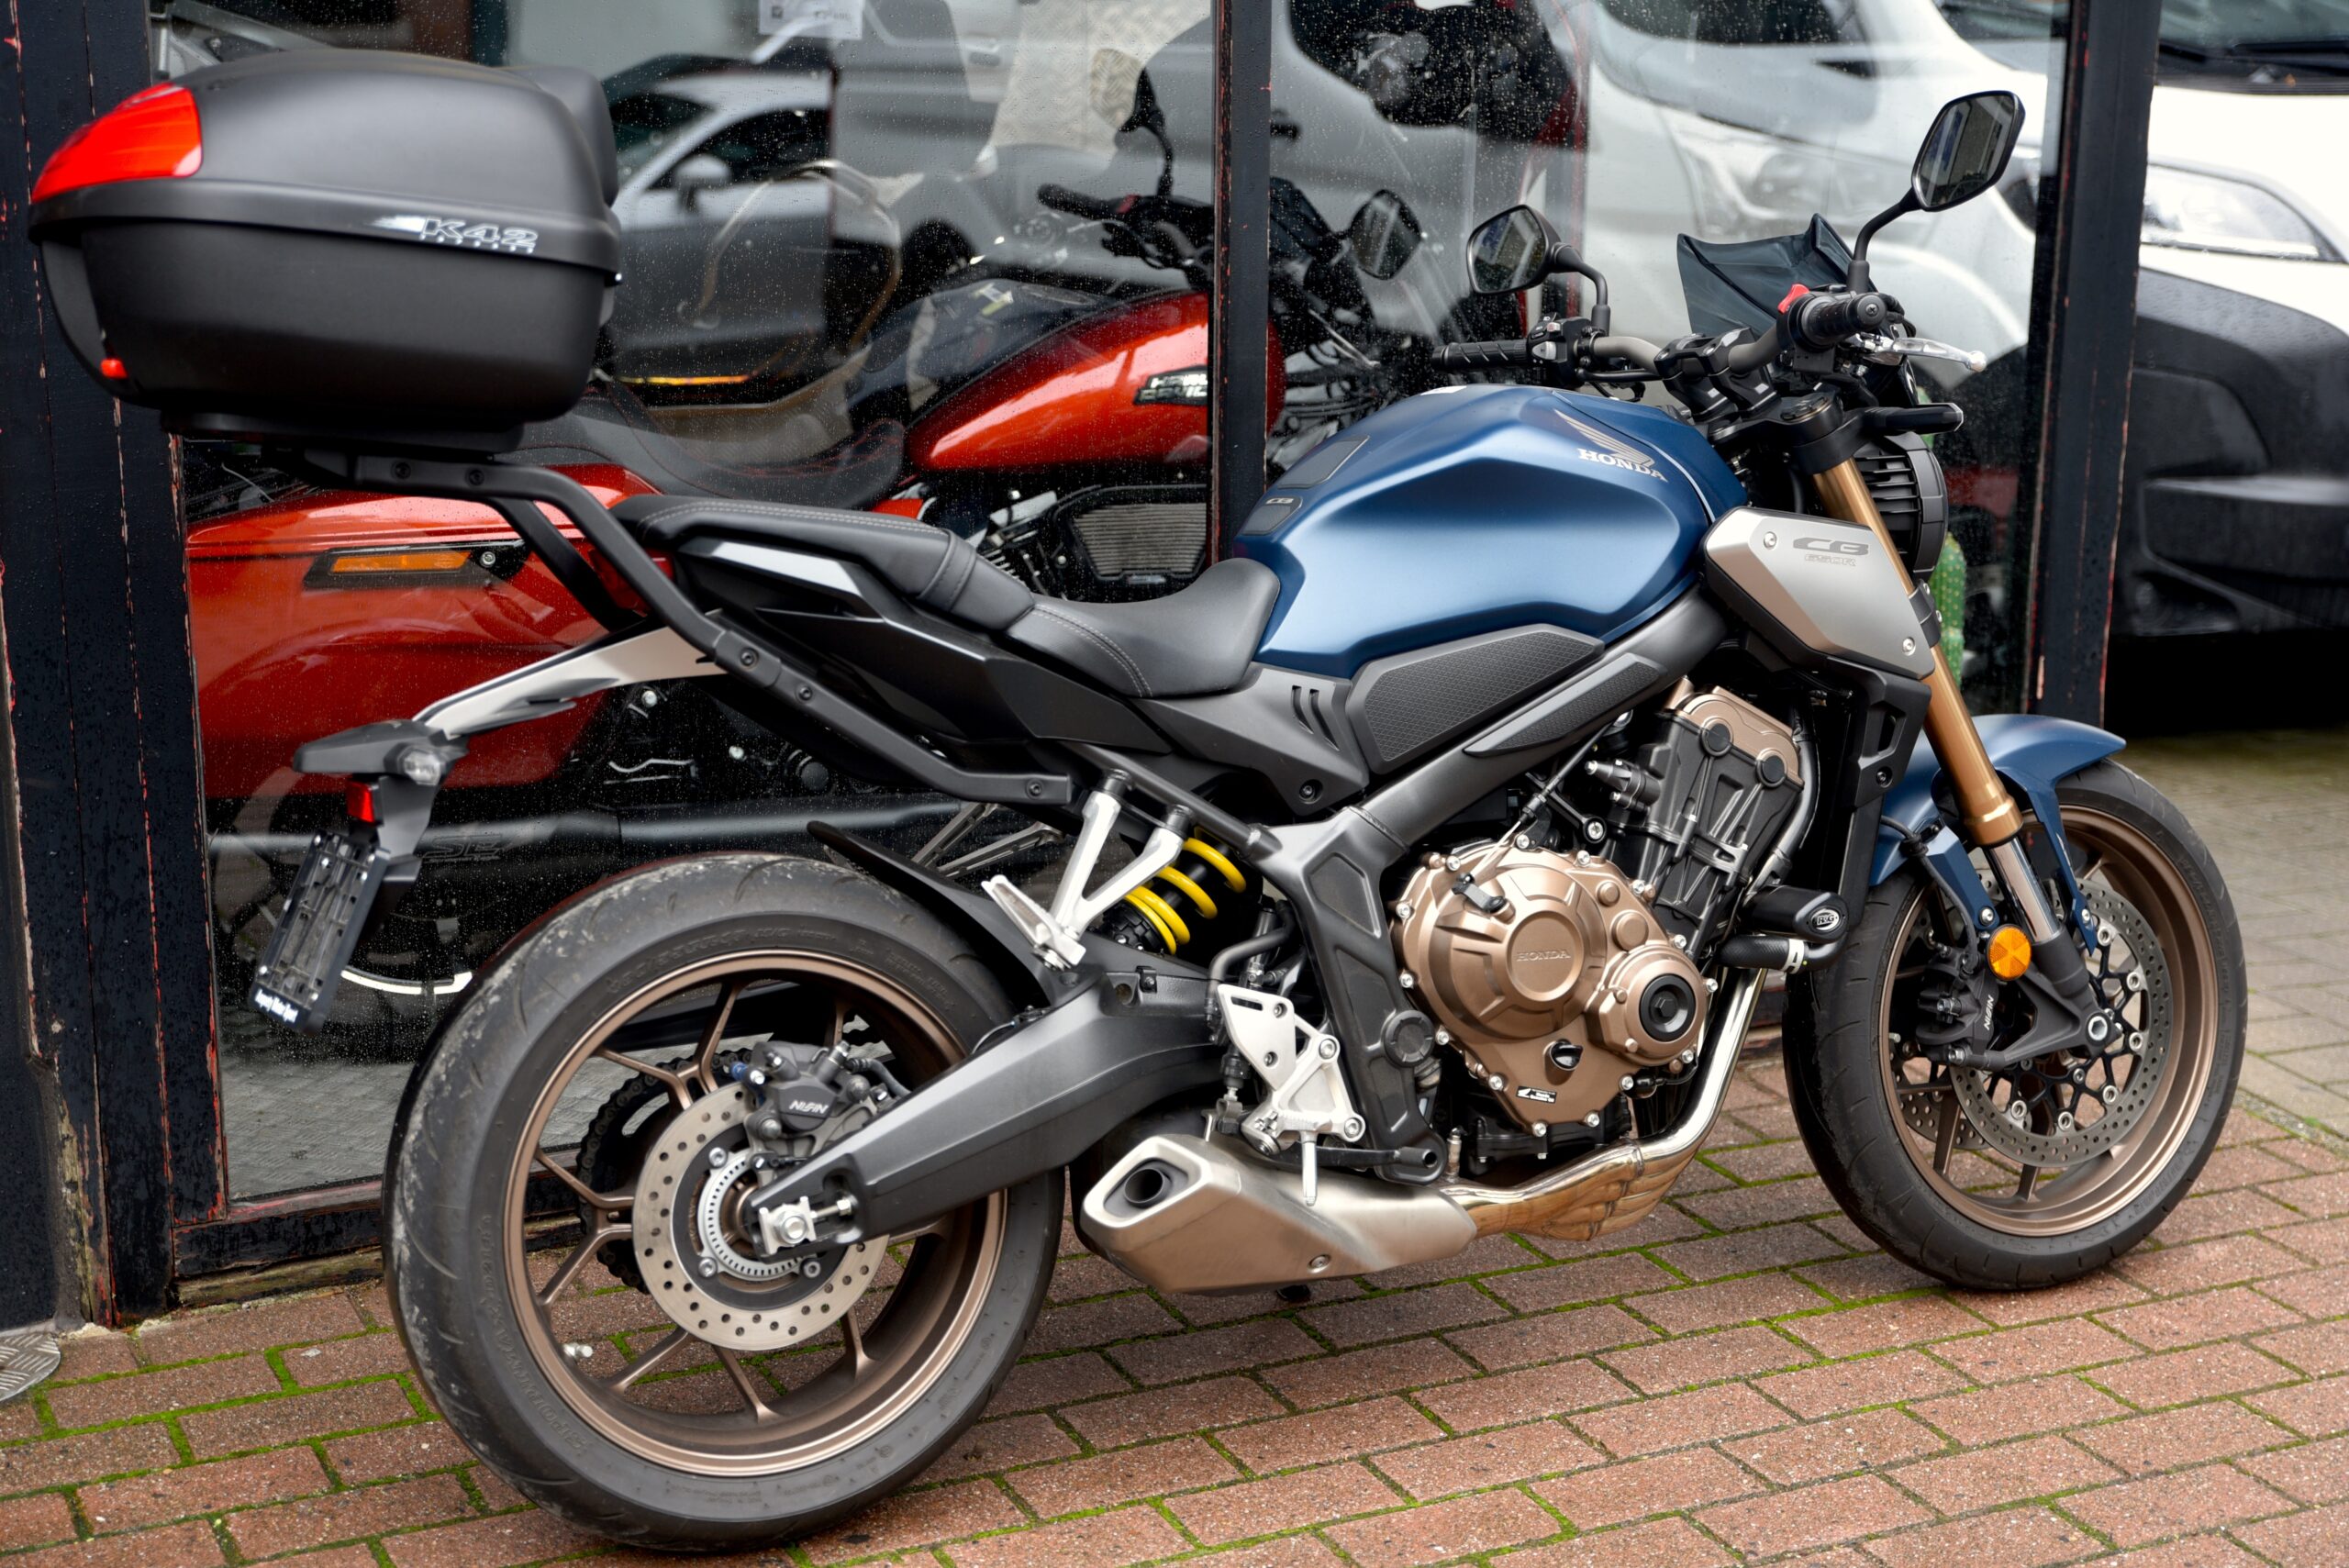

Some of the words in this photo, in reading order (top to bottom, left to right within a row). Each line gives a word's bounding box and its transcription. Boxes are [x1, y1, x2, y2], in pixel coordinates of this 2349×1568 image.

[423, 217, 539, 248] K42
[1576, 448, 1669, 483] HONDA
[1792, 537, 1869, 556] CB
[1516, 949, 1572, 962] HONDA
